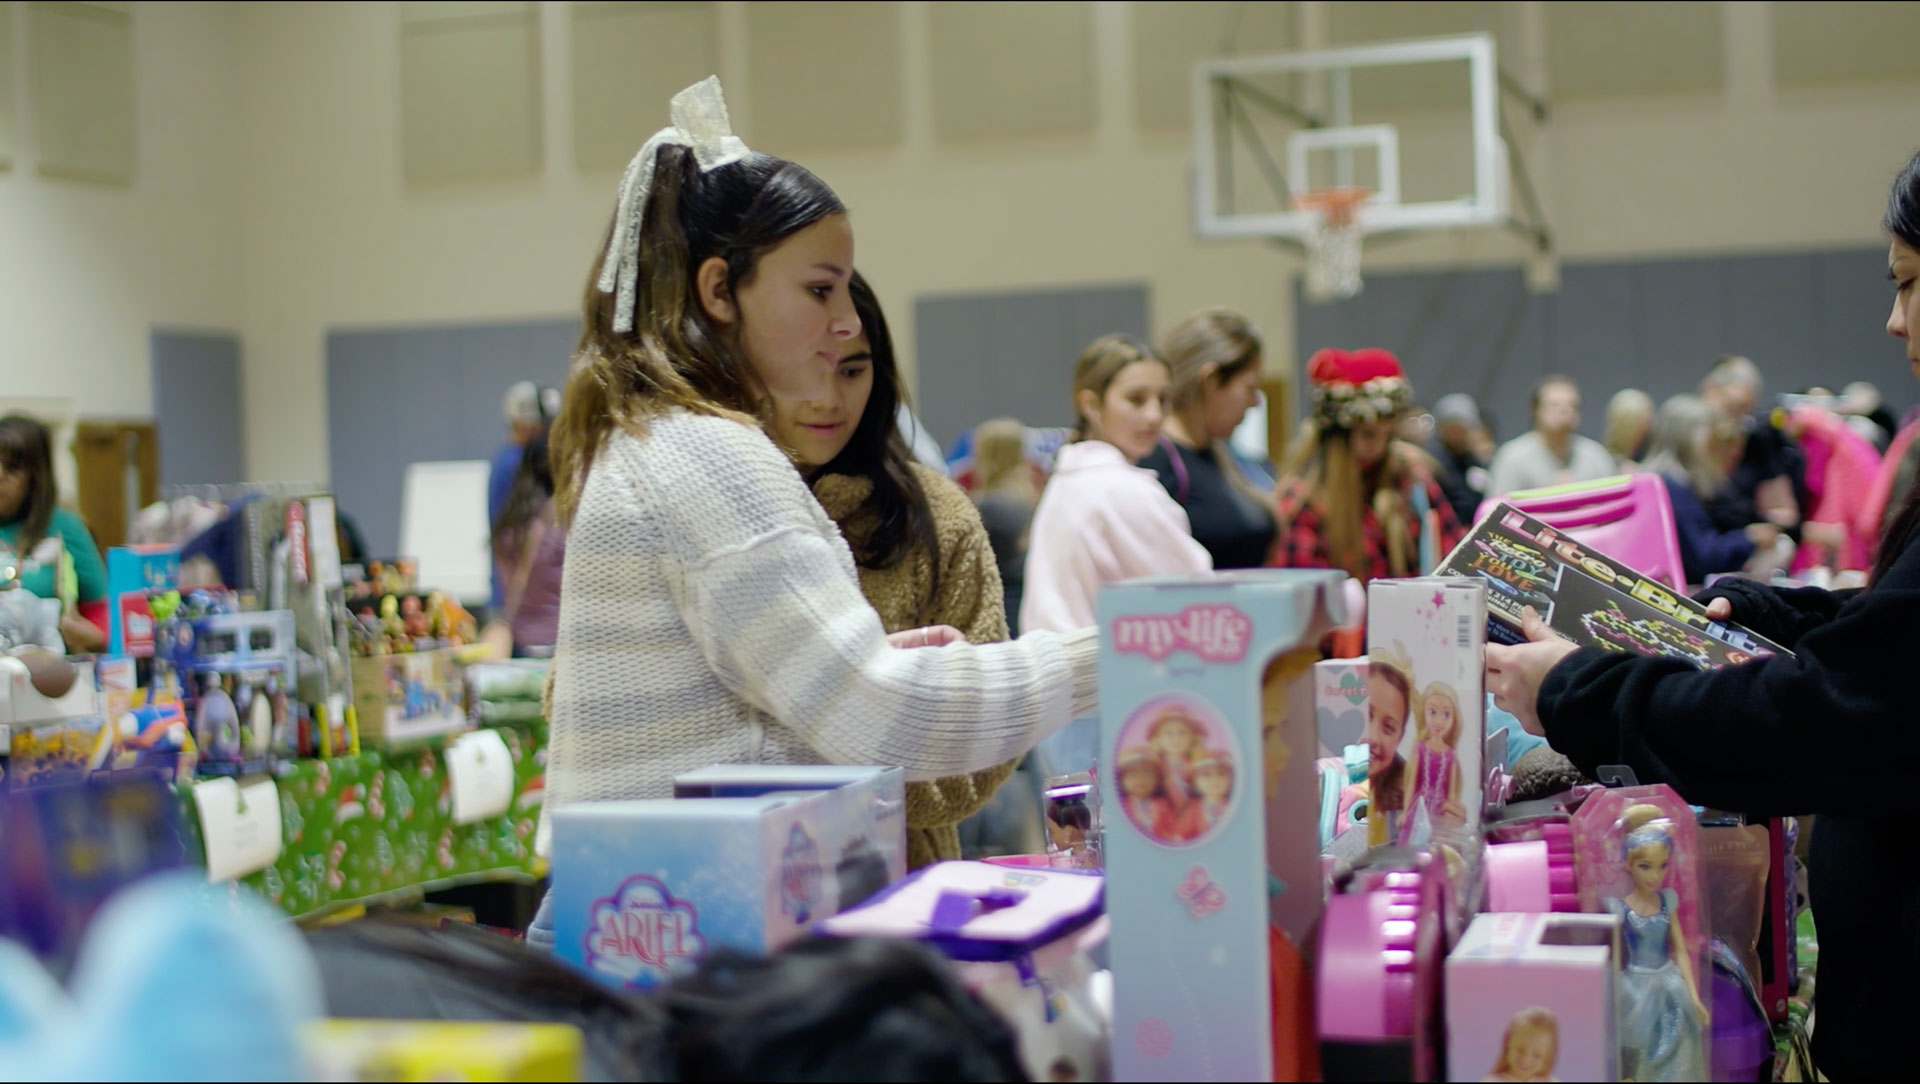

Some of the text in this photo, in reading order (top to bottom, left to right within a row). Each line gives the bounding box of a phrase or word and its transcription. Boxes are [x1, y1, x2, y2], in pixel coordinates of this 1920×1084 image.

[1472, 558, 1537, 591] LOVE
[1479, 551, 1513, 570] YOU
[1499, 552, 1543, 575] TOY
[599, 912, 692, 970] ARIEL
